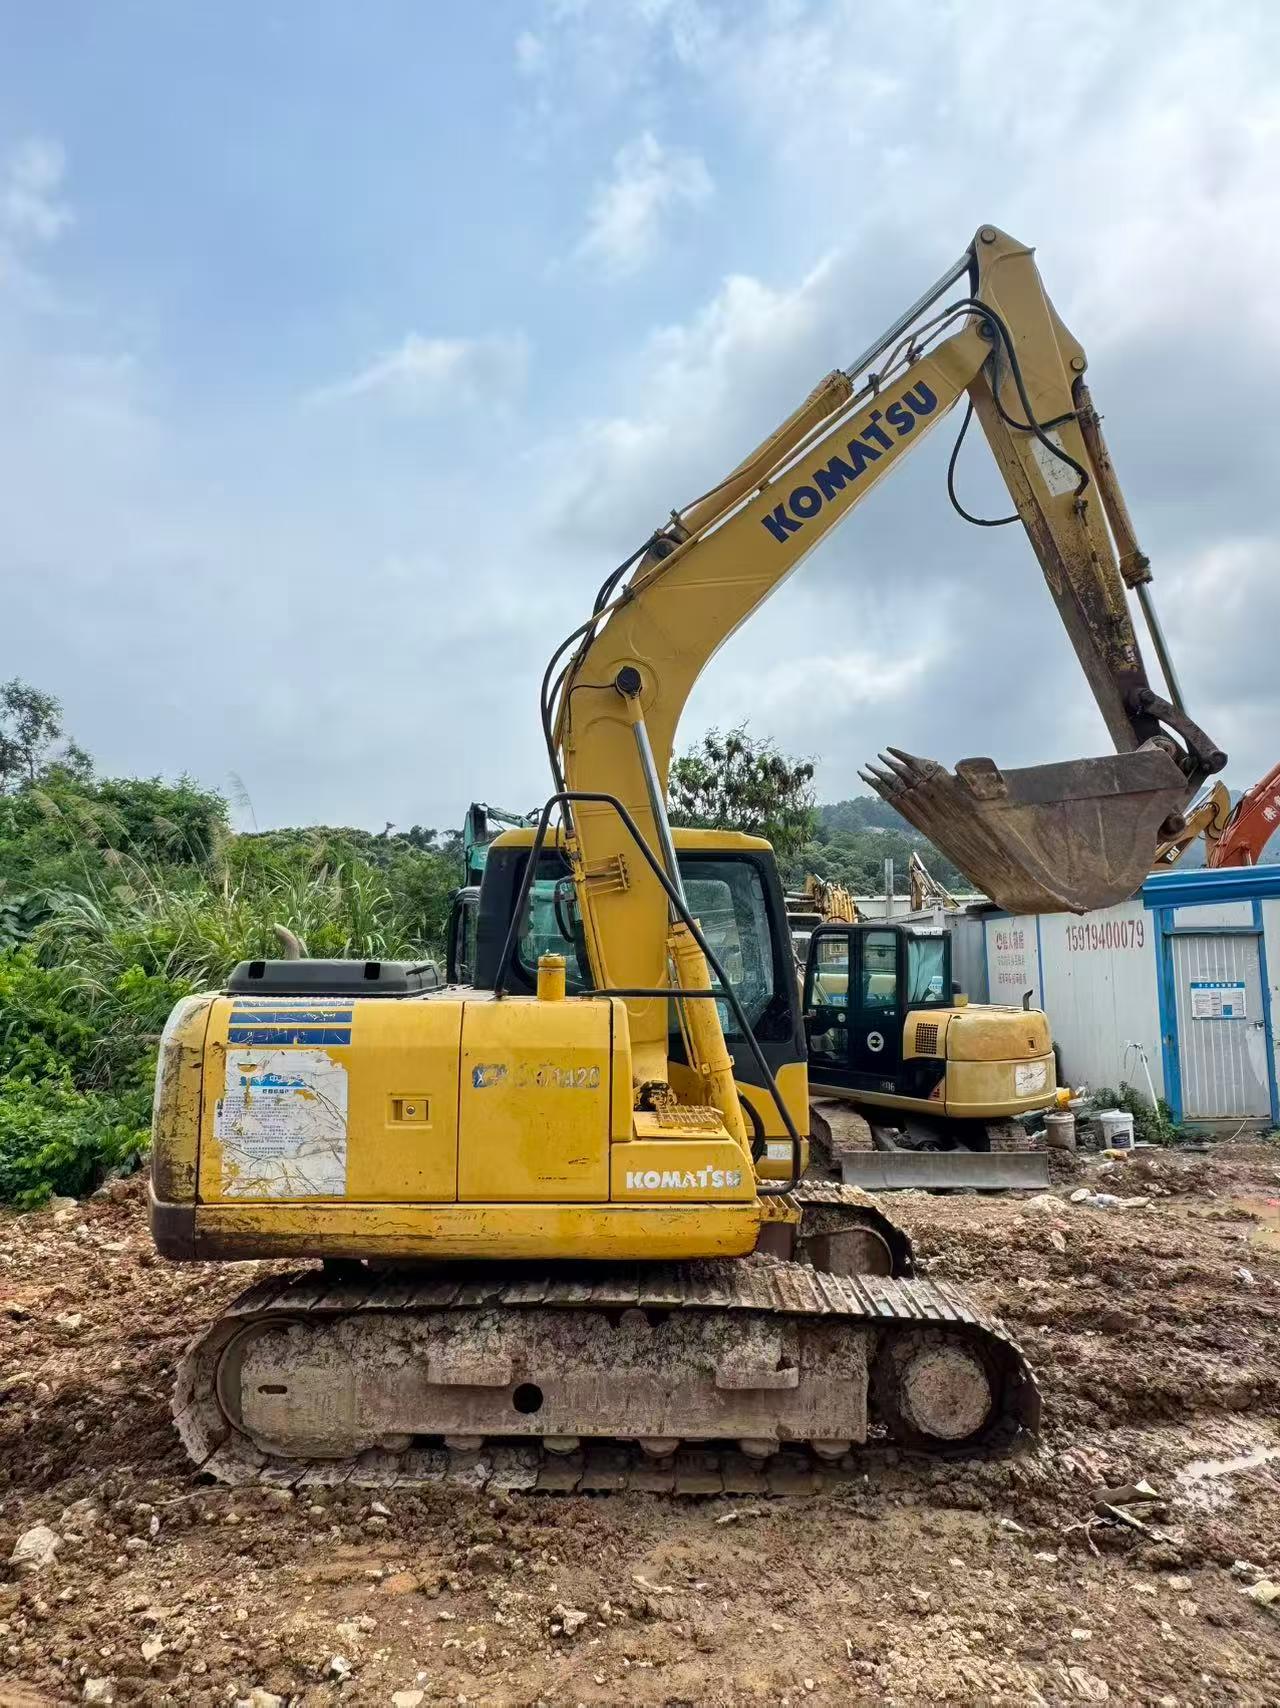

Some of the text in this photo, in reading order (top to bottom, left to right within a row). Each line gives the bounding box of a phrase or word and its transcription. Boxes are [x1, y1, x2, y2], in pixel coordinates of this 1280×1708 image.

[761, 380, 938, 544] KOMATSU
[1166, 845, 1181, 862] CAT
[1065, 919, 1145, 951] 15919400079
[626, 1165, 741, 1189] KOMATSU
